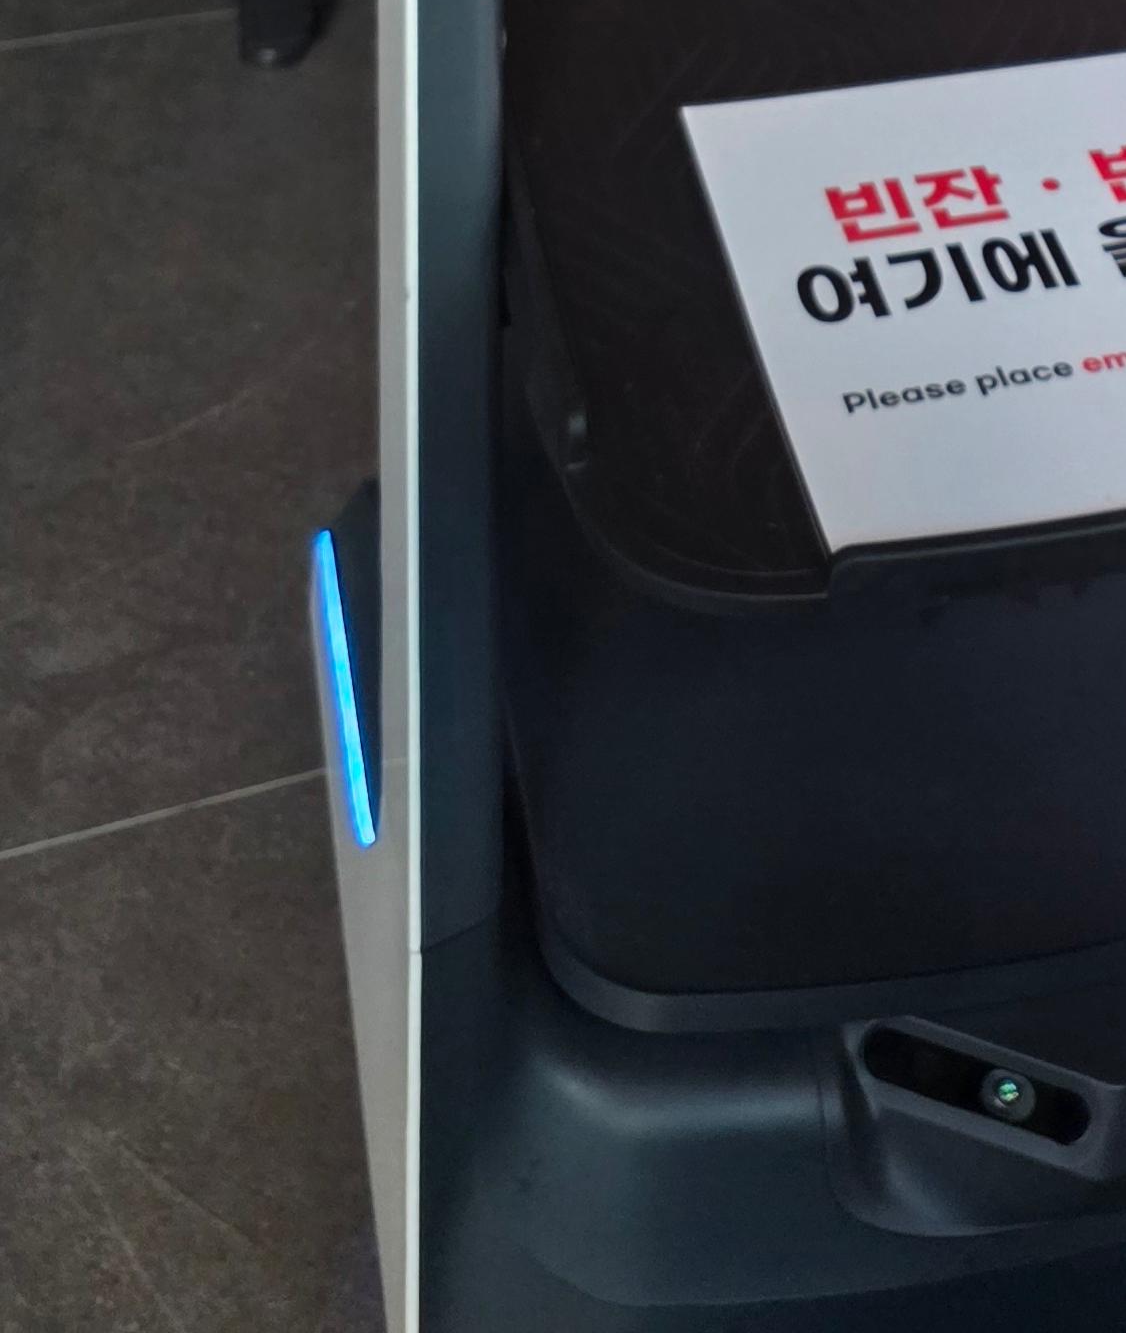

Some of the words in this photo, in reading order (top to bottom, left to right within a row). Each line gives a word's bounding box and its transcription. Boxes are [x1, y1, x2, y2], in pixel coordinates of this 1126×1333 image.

[825, 166, 1009, 243] 빈잔
[796, 230, 1079, 323] 여기에
[843, 380, 966, 414] Please
[976, 363, 1073, 397] place
